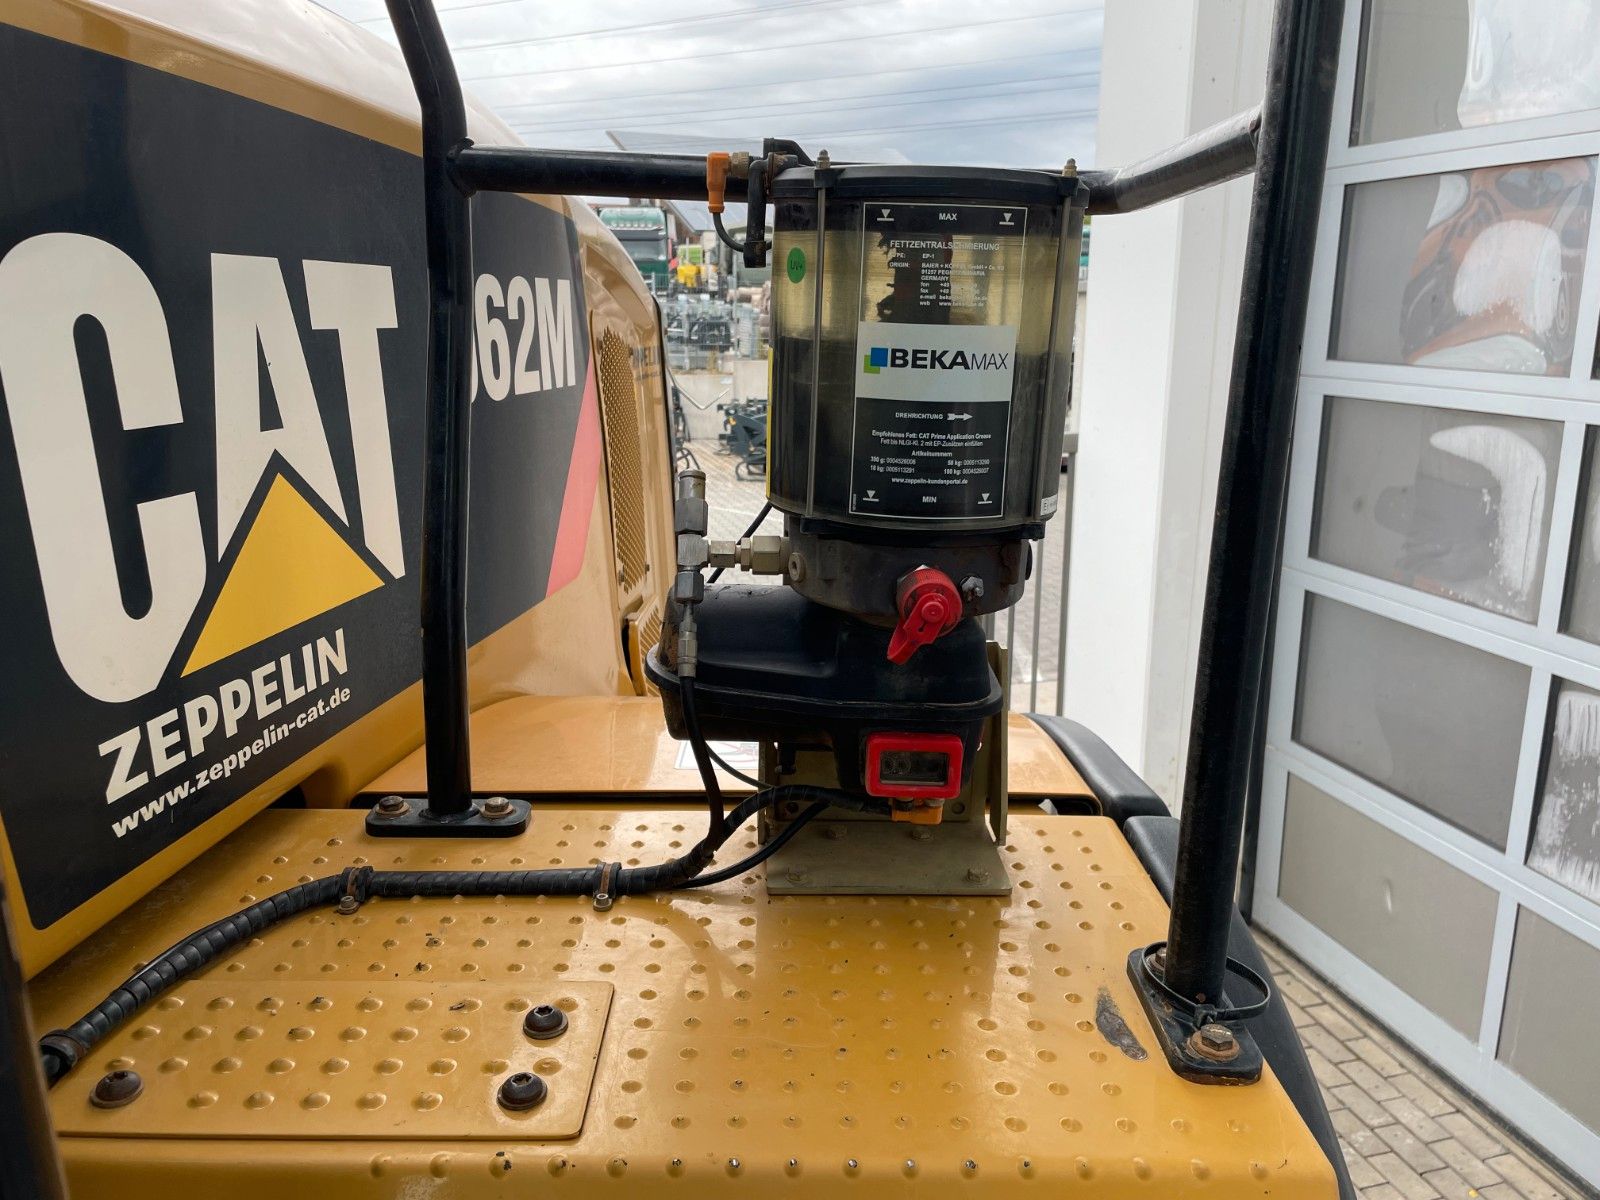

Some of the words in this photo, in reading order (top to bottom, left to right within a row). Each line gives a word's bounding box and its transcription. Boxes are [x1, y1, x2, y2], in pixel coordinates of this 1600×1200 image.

[890, 240, 1000, 250] FETTZENTRALSCHMIERUNG
[939, 212, 958, 220] MAX
[471, 273, 576, 404] 62M
[0, 232, 405, 703] CAT
[99, 628, 349, 804] ZEPPELIN
[112, 686, 351, 838] www.zeppelin-cat.de
